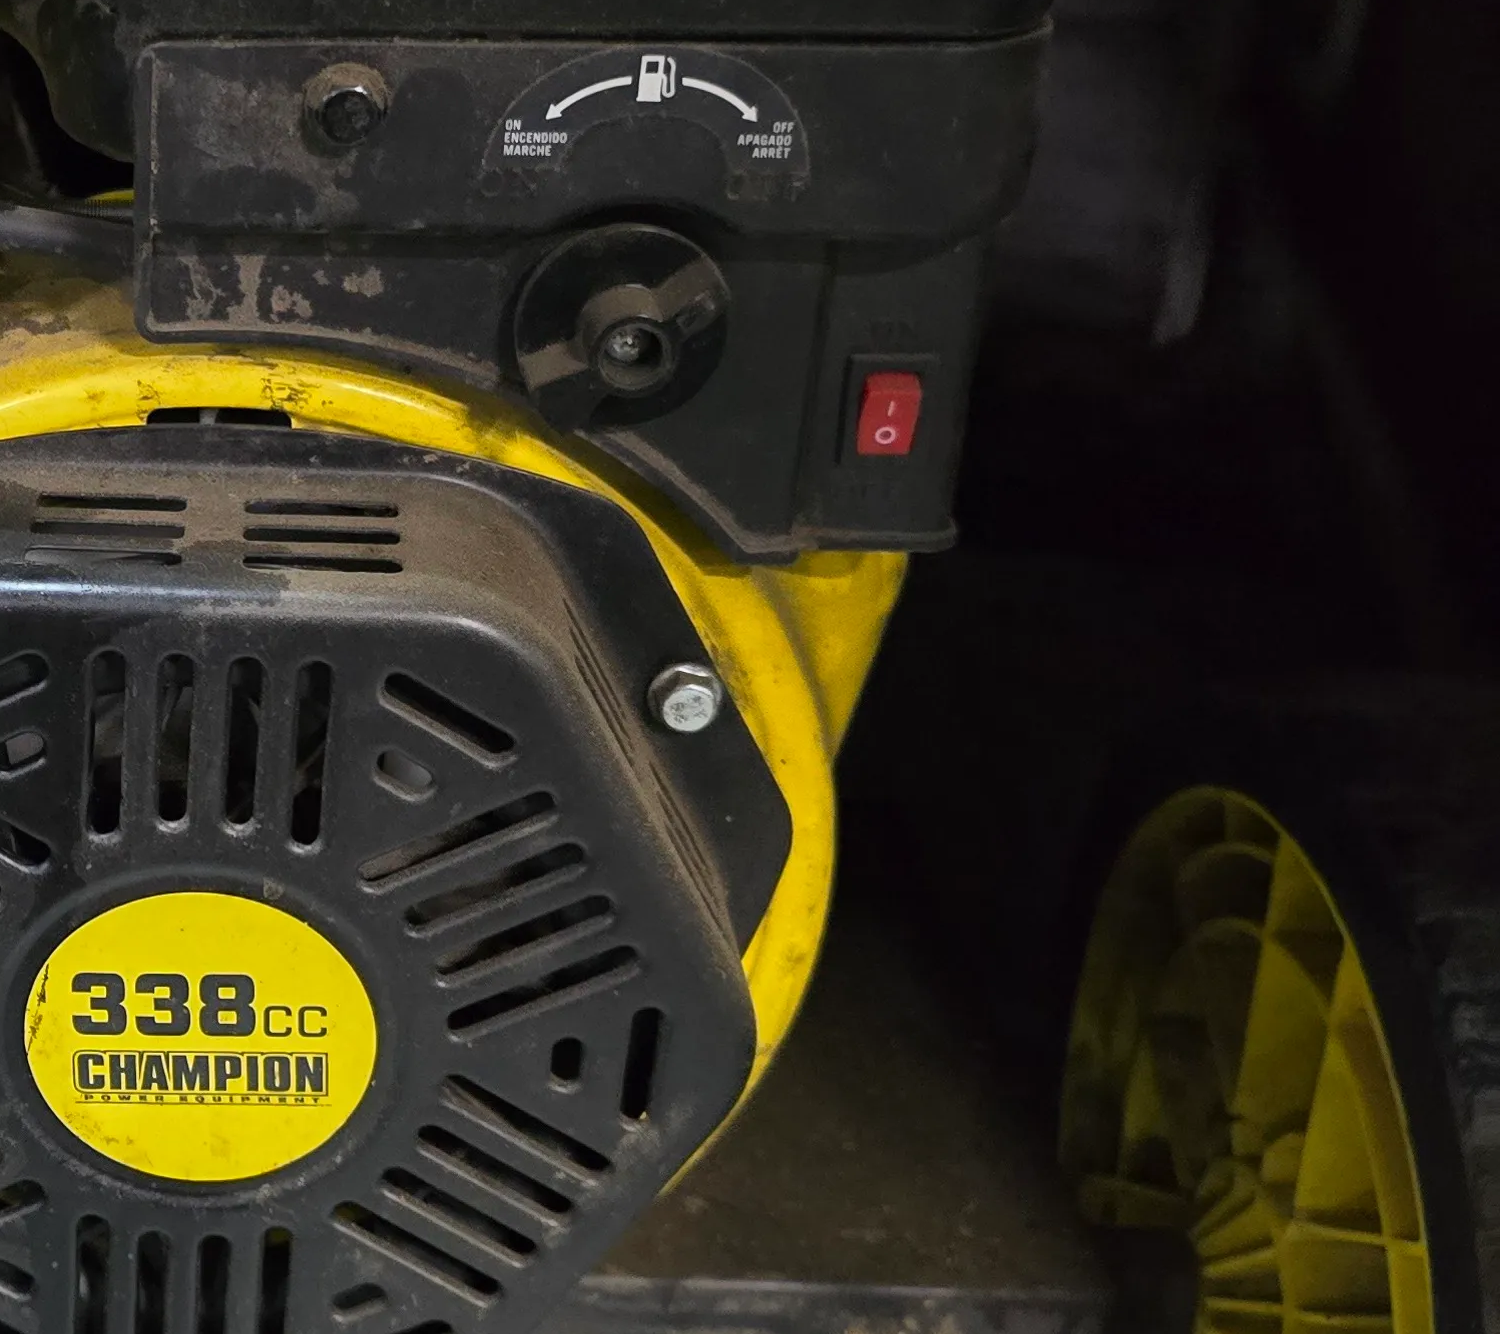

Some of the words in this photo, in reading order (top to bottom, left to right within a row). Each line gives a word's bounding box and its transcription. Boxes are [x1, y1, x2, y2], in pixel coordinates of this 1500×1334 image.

[505, 120, 522, 131] ON
[772, 121, 795, 133] OFF
[503, 132, 568, 144] ENCENDIDO
[737, 134, 792, 146] APAGADO
[503, 145, 552, 156] MARCHE
[752, 146, 791, 159] ARRÊT
[76, 1053, 324, 1093] CHAMPION
[83, 1094, 165, 1103] POWER
[179, 1095, 321, 1105] EQUIPMENT
